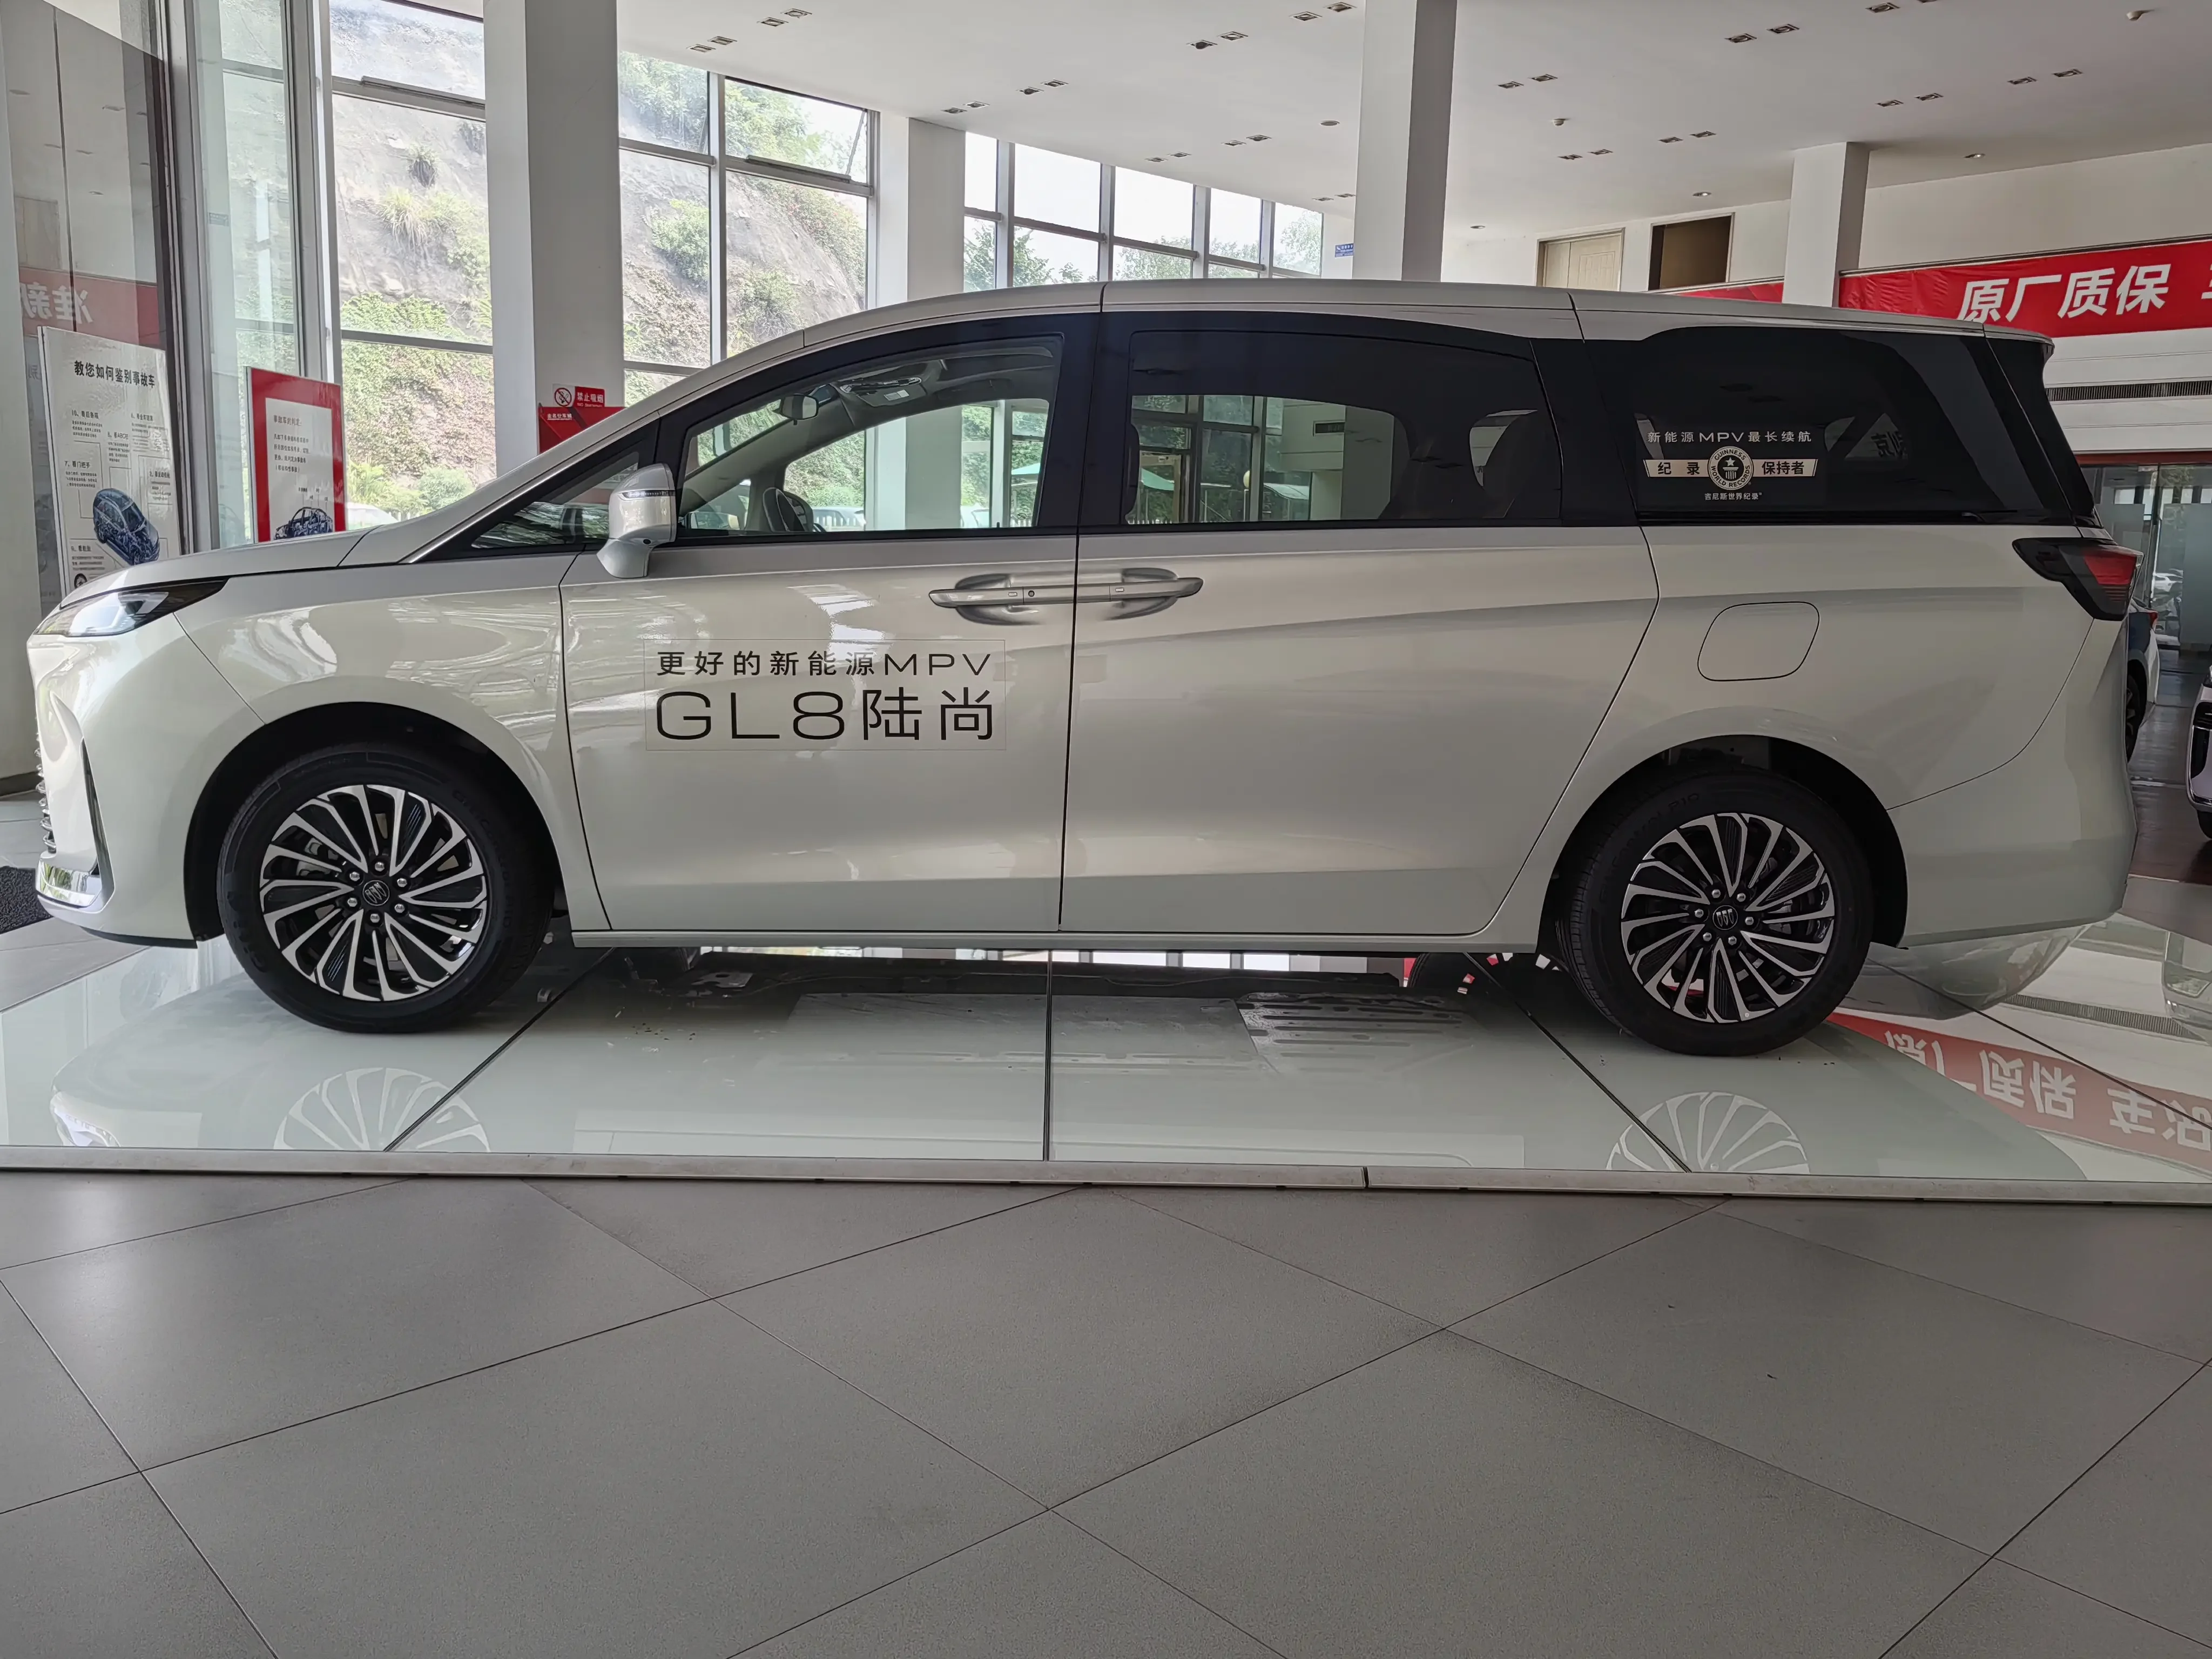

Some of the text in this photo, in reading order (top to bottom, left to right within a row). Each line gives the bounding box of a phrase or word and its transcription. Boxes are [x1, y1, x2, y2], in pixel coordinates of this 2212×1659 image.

[1958, 264, 2171, 323] 原厂质保
[74, 360, 155, 388] 教您如何鉴别事故车
[1648, 431, 1812, 443] 新能源MPV最长续航
[1714, 449, 1746, 460] GUINNESS
[1657, 461, 1804, 475] 纪录 保持者
[1711, 465, 1750, 488] WORLD RECORDS
[656, 650, 991, 676] 更好的新能源MPV
[656, 686, 994, 740] GL8陆尚
